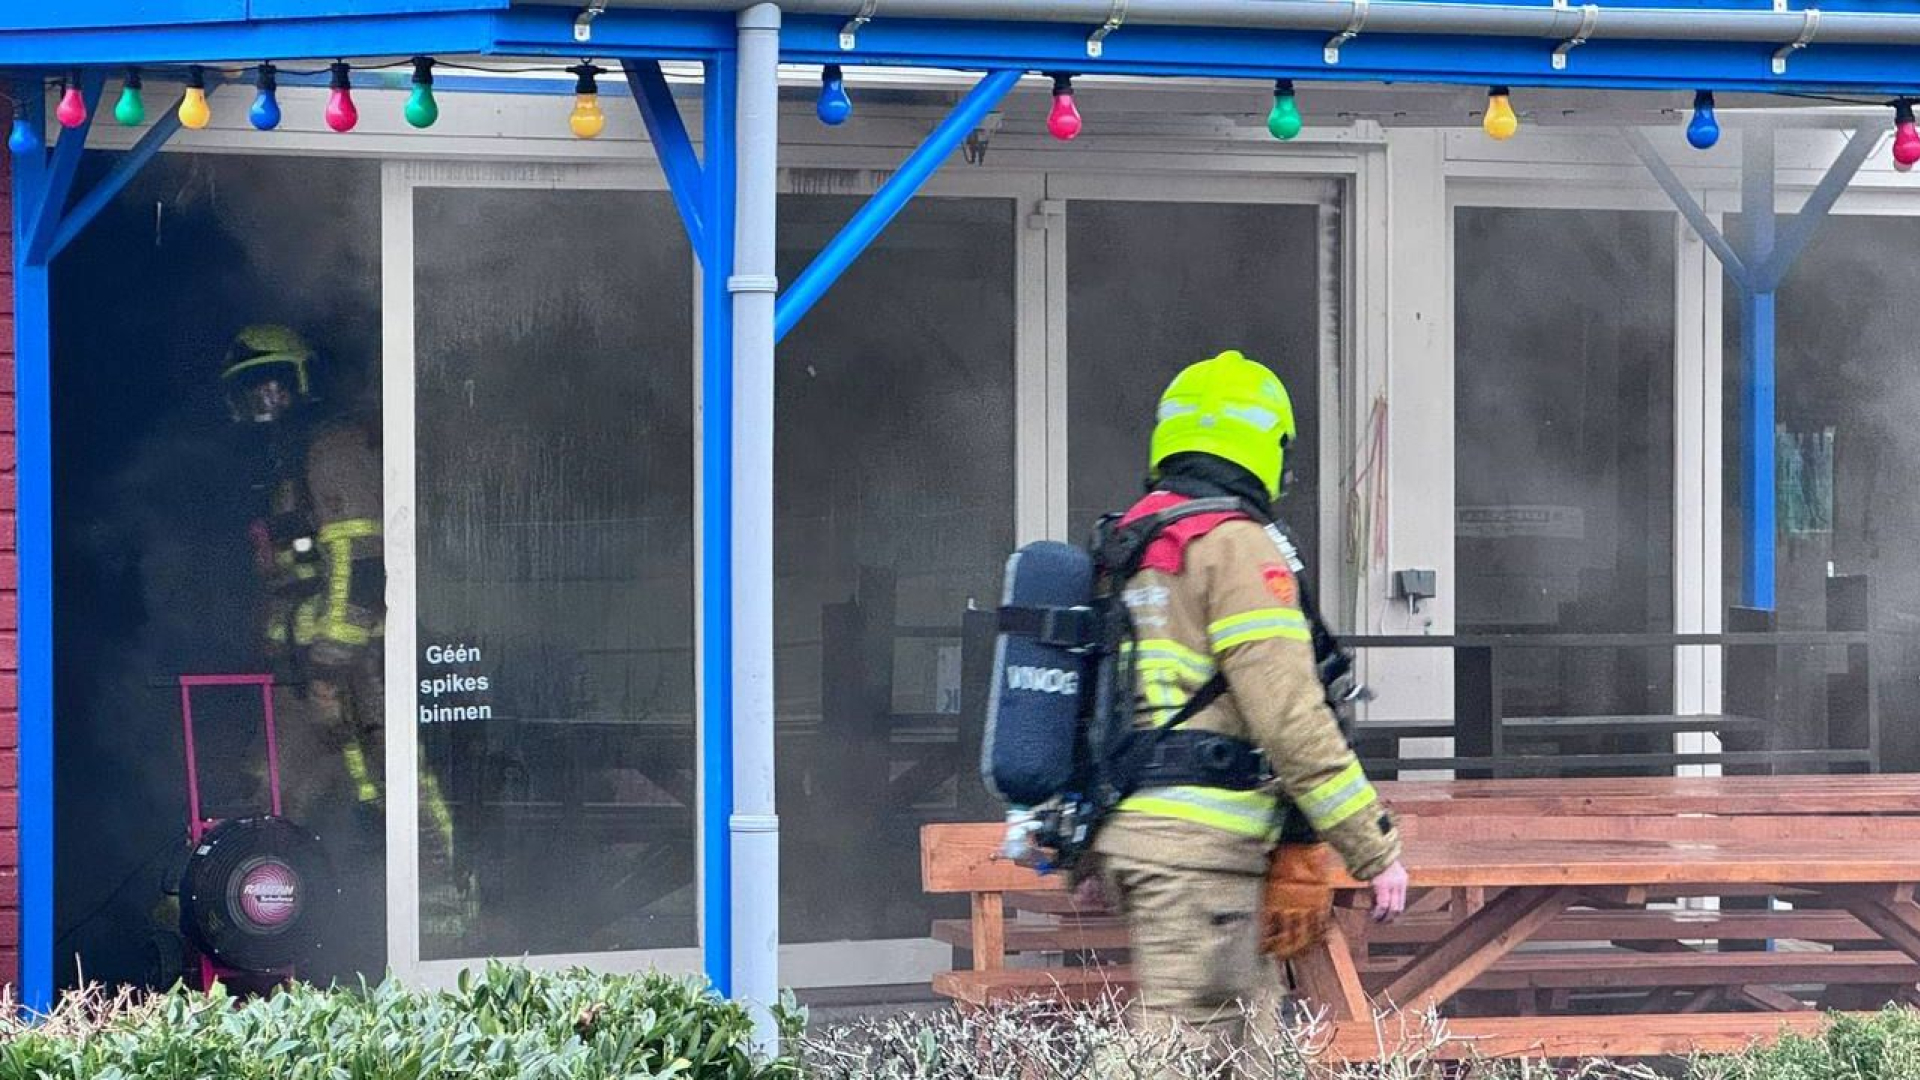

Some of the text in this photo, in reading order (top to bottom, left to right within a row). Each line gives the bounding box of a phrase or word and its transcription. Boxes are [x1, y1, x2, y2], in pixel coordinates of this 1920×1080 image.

[426, 643, 481, 664] Géén
[420, 673, 489, 697] spikes
[420, 704, 492, 723] binnen
